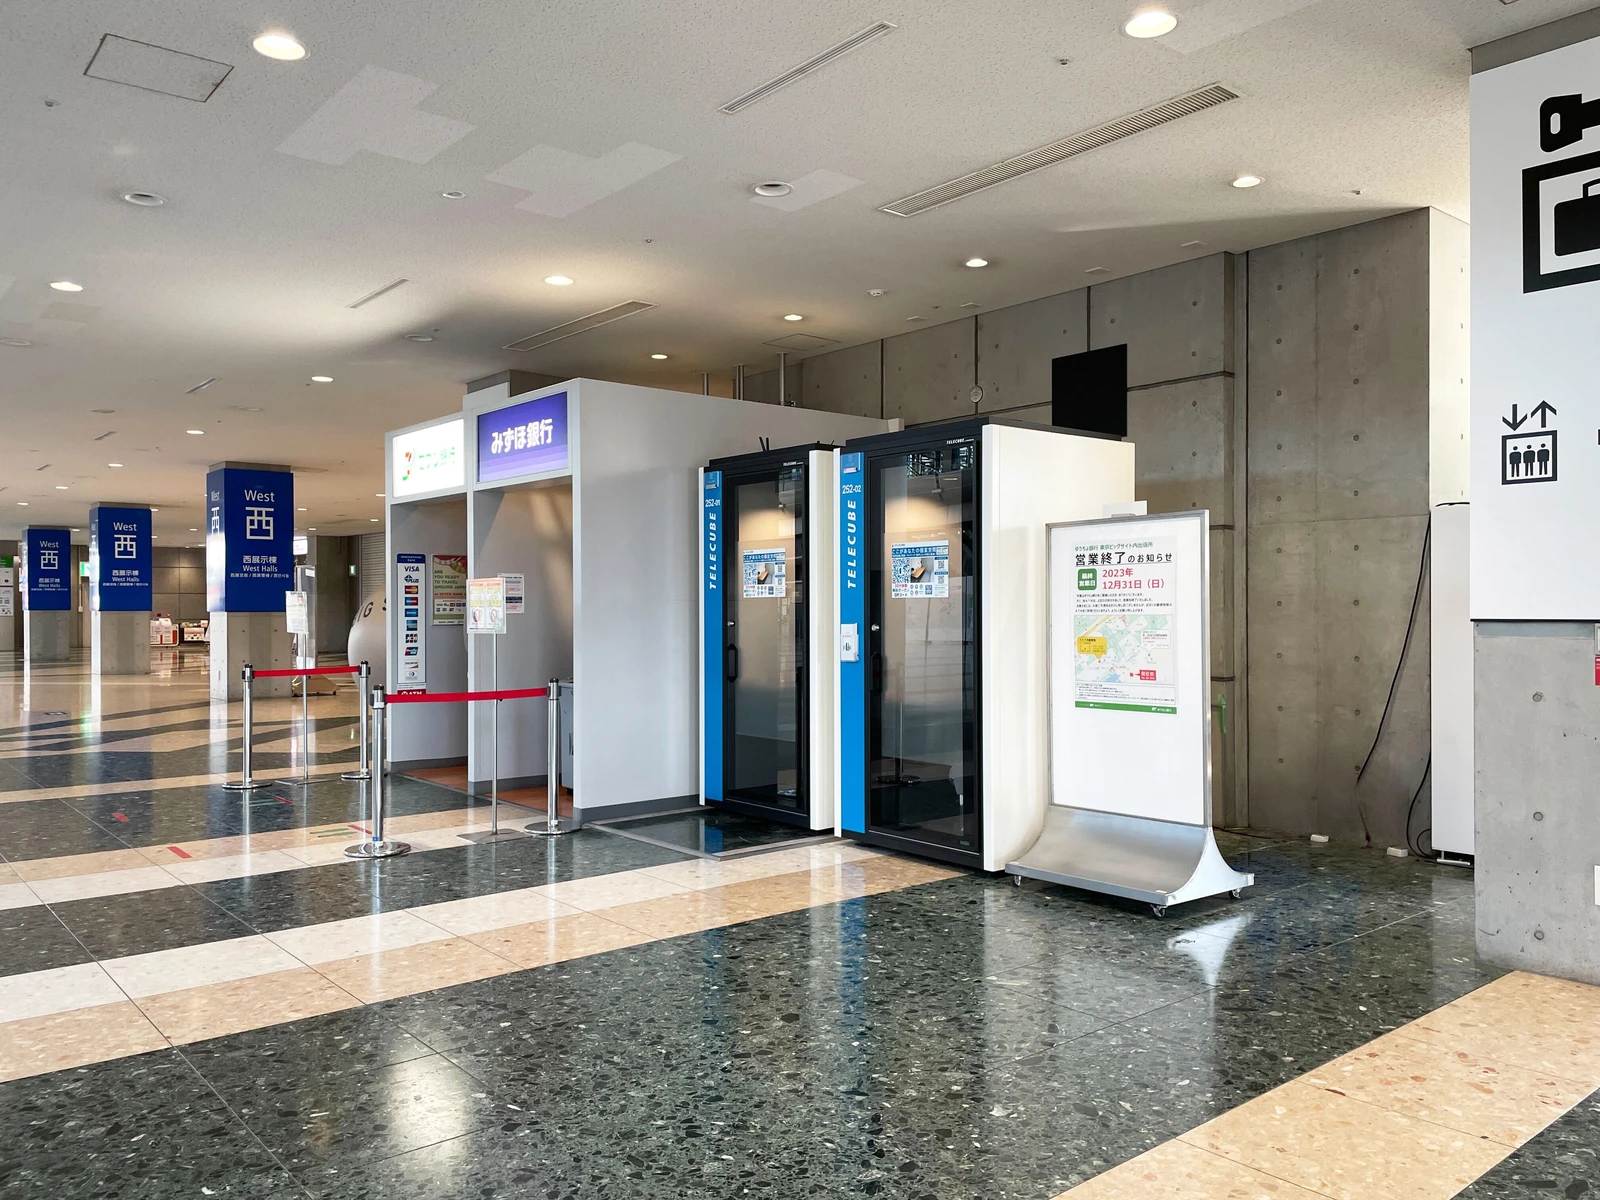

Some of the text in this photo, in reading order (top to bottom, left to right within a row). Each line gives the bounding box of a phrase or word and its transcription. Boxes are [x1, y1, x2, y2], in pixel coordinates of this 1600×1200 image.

[491, 418, 554, 454] みずほ銀行
[244, 489, 275, 502] West
[842, 484, 862, 495] 252-02
[705, 499, 721, 508] 252-01
[113, 521, 138, 532] West
[245, 506, 275, 540] 西
[114, 534, 137, 559] 西
[709, 512, 717, 590] TELECUBE
[848, 500, 857, 589] TELECUBE
[1075, 544, 1099, 552] ゆうちょ銀行
[40, 550, 59, 570] 西
[243, 555, 278, 564] 西展示棟
[1076, 551, 1173, 566] 営業終了のお知らせ
[243, 564, 278, 573] West Halls
[1102, 567, 1134, 578] 2023年
